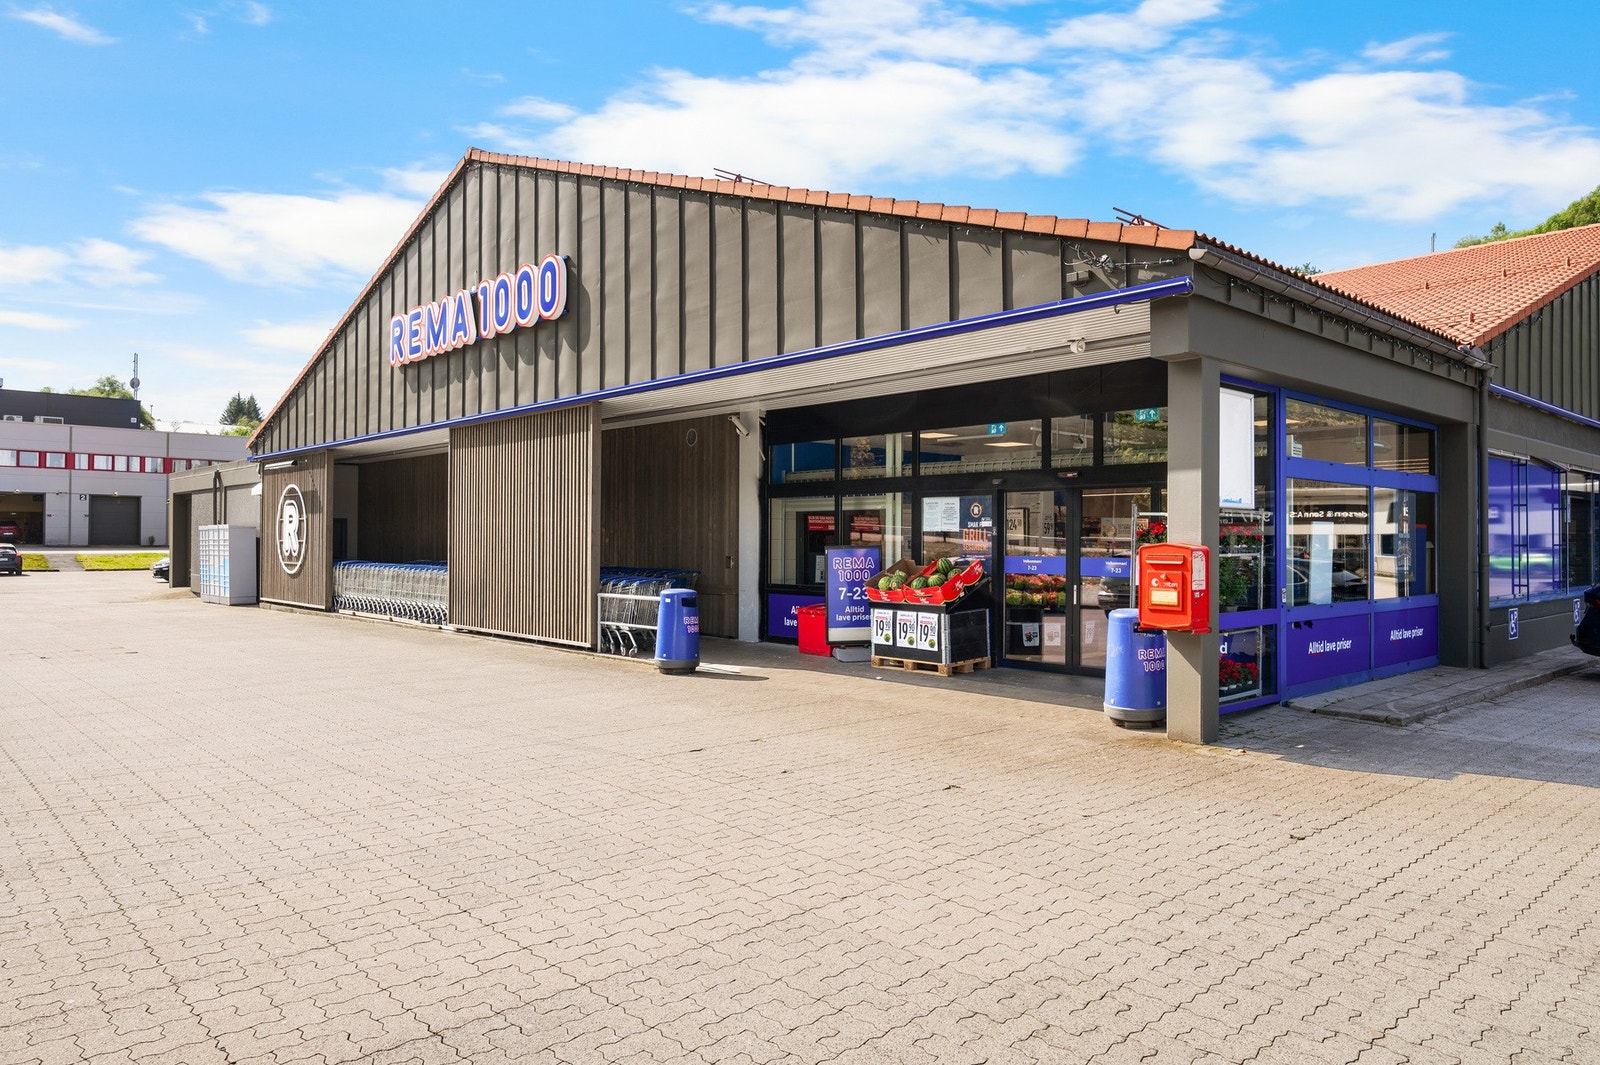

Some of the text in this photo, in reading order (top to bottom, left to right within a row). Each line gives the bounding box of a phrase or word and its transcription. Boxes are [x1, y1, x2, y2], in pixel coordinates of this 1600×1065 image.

[390, 253, 567, 367] REMA 1000
[283, 500, 299, 556] R
[832, 557, 875, 570] REMA
[837, 570, 870, 582] 1000
[838, 587, 869, 601] 7-23
[844, 605, 865, 613] Alltid
[784, 616, 798, 627] lave
[875, 619, 885, 637] 19
[898, 622, 908, 640] 19
[919, 624, 929, 642] 19
[1389, 625, 1424, 642] Alltid lave priser
[1137, 647, 1165, 660] REM
[1308, 637, 1352, 655] Alltid lave priser
